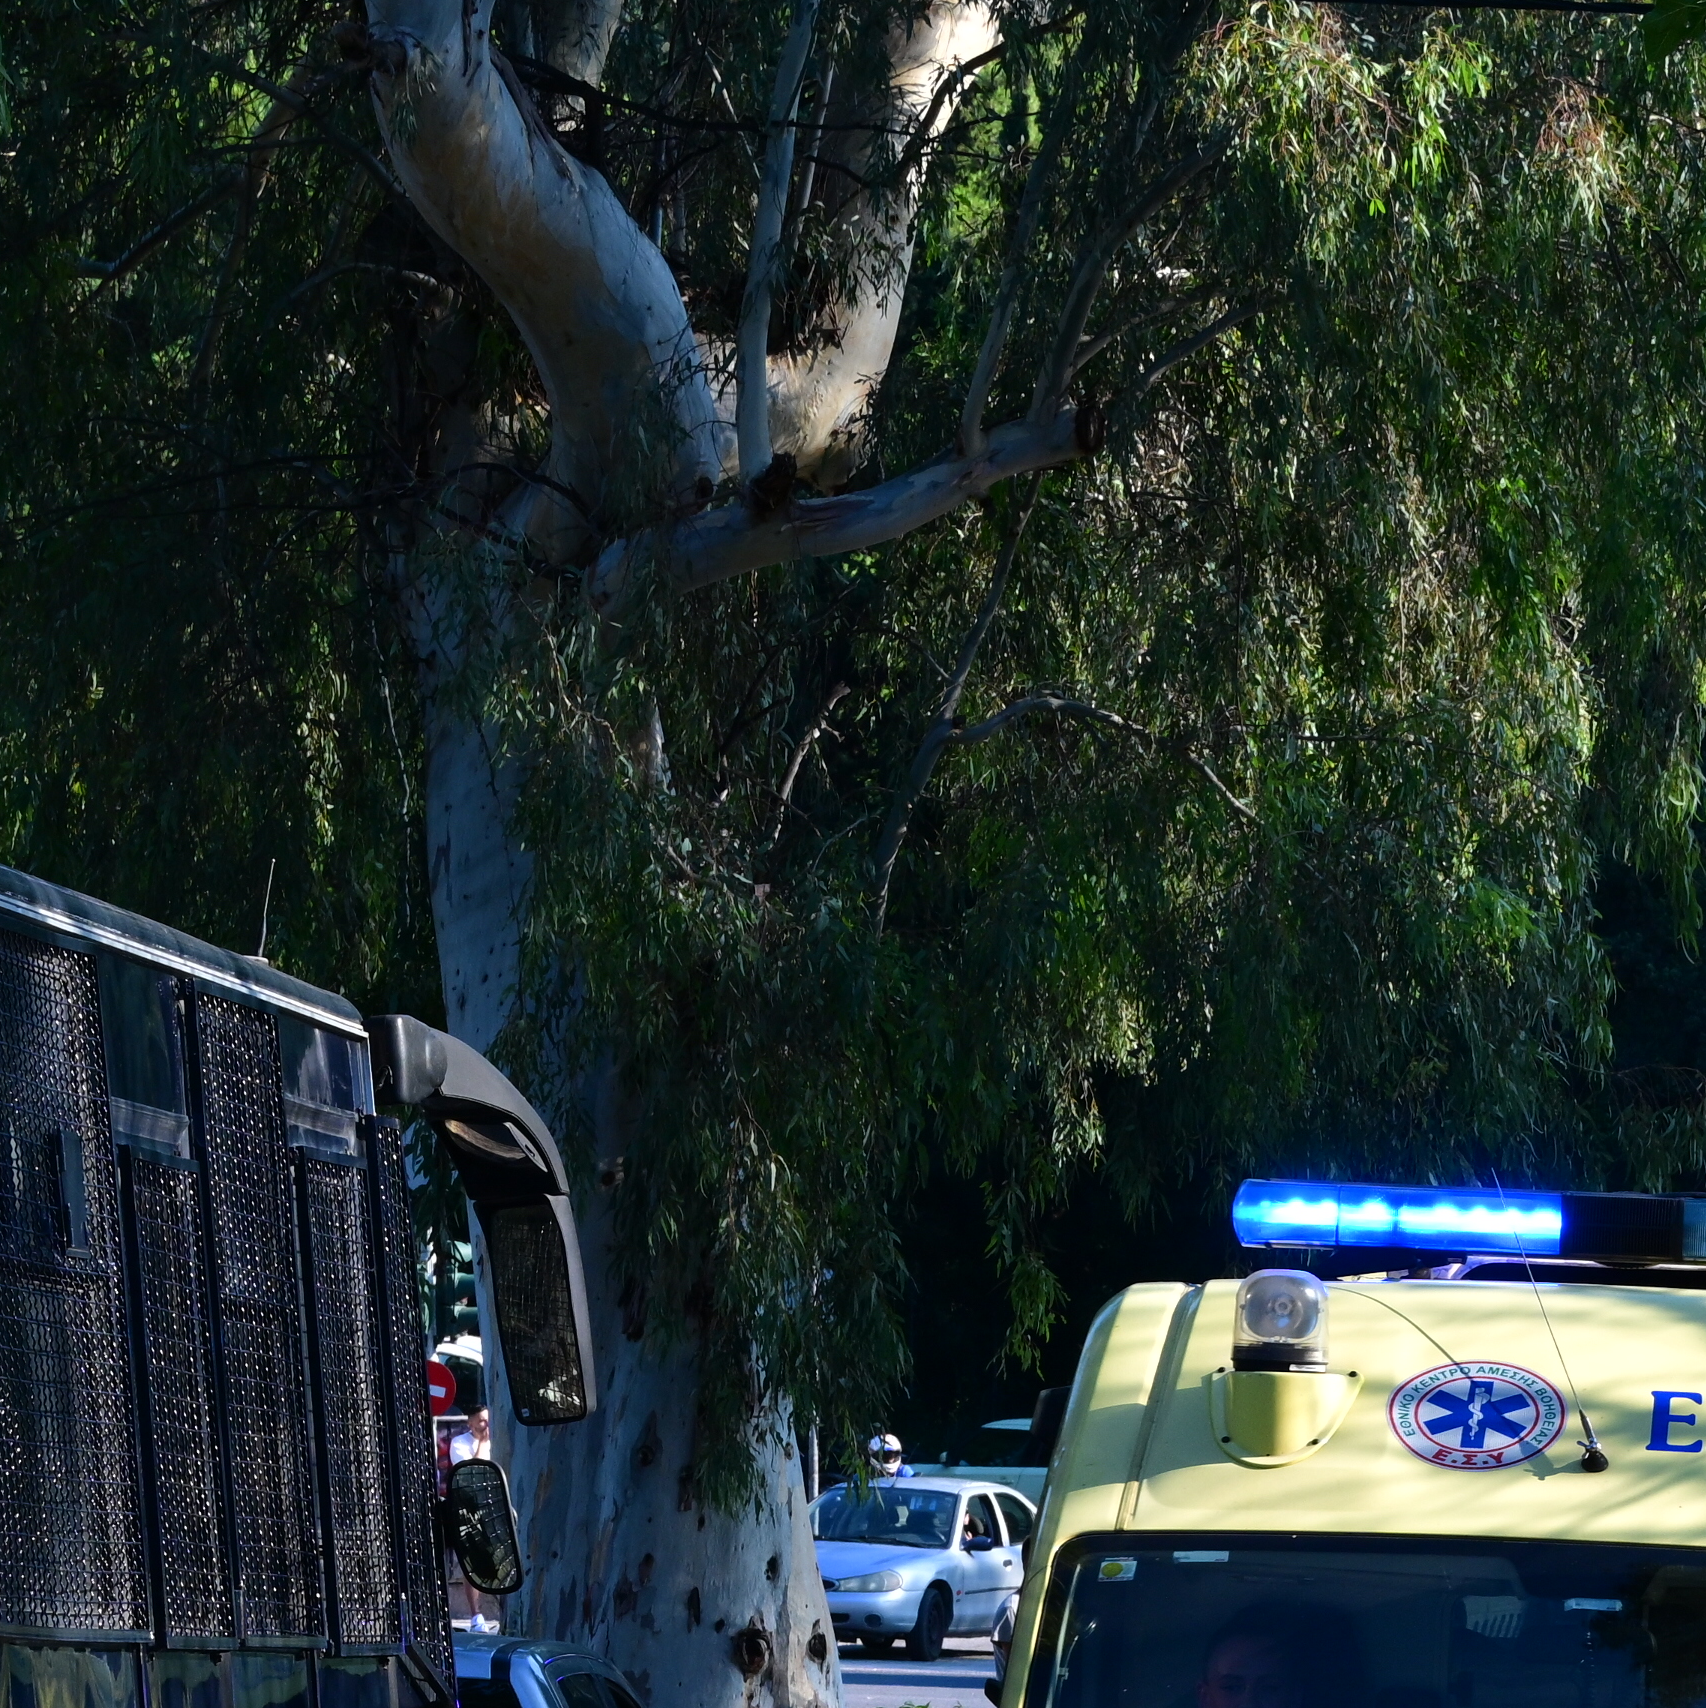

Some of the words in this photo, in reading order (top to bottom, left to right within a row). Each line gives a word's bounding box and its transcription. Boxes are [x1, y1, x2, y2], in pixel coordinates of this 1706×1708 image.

[1397, 1393, 1415, 1437] ΕΘΝΙΚΟ
[1412, 1366, 1471, 1394] ΚΕΝΤΡΟ
[1476, 1365, 1539, 1389] ΑΜΕΣΗΣ
[1529, 1387, 1557, 1446] ΒΟΗΘΕΙΑΣ
[1431, 1448, 1505, 1466] Ε.Σ.Υ
